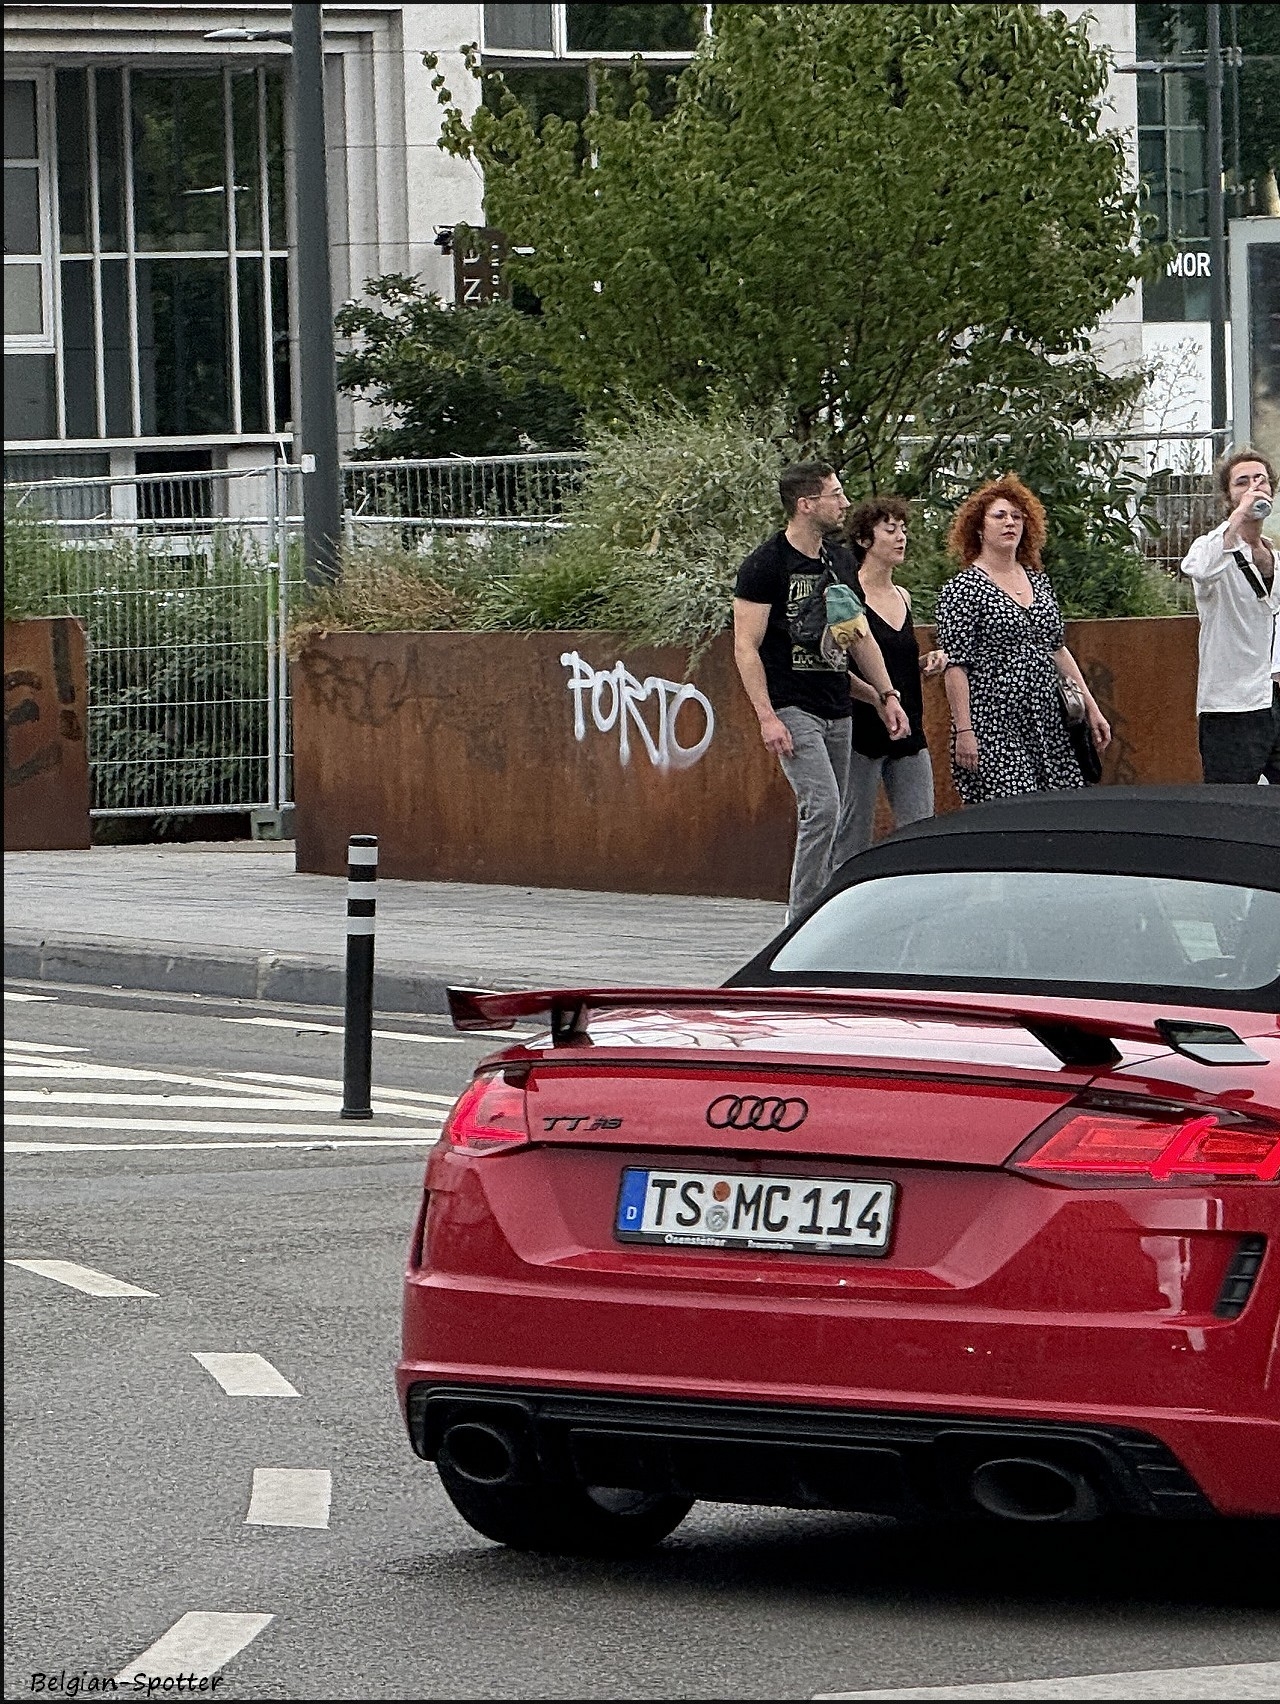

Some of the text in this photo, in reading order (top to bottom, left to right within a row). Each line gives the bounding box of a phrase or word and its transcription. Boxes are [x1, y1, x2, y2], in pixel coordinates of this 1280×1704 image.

[560, 651, 714, 776] PORTO
[543, 1116, 590, 1131] TT
[626, 1206, 637, 1219] D
[652, 1179, 883, 1238] TS MC 114
